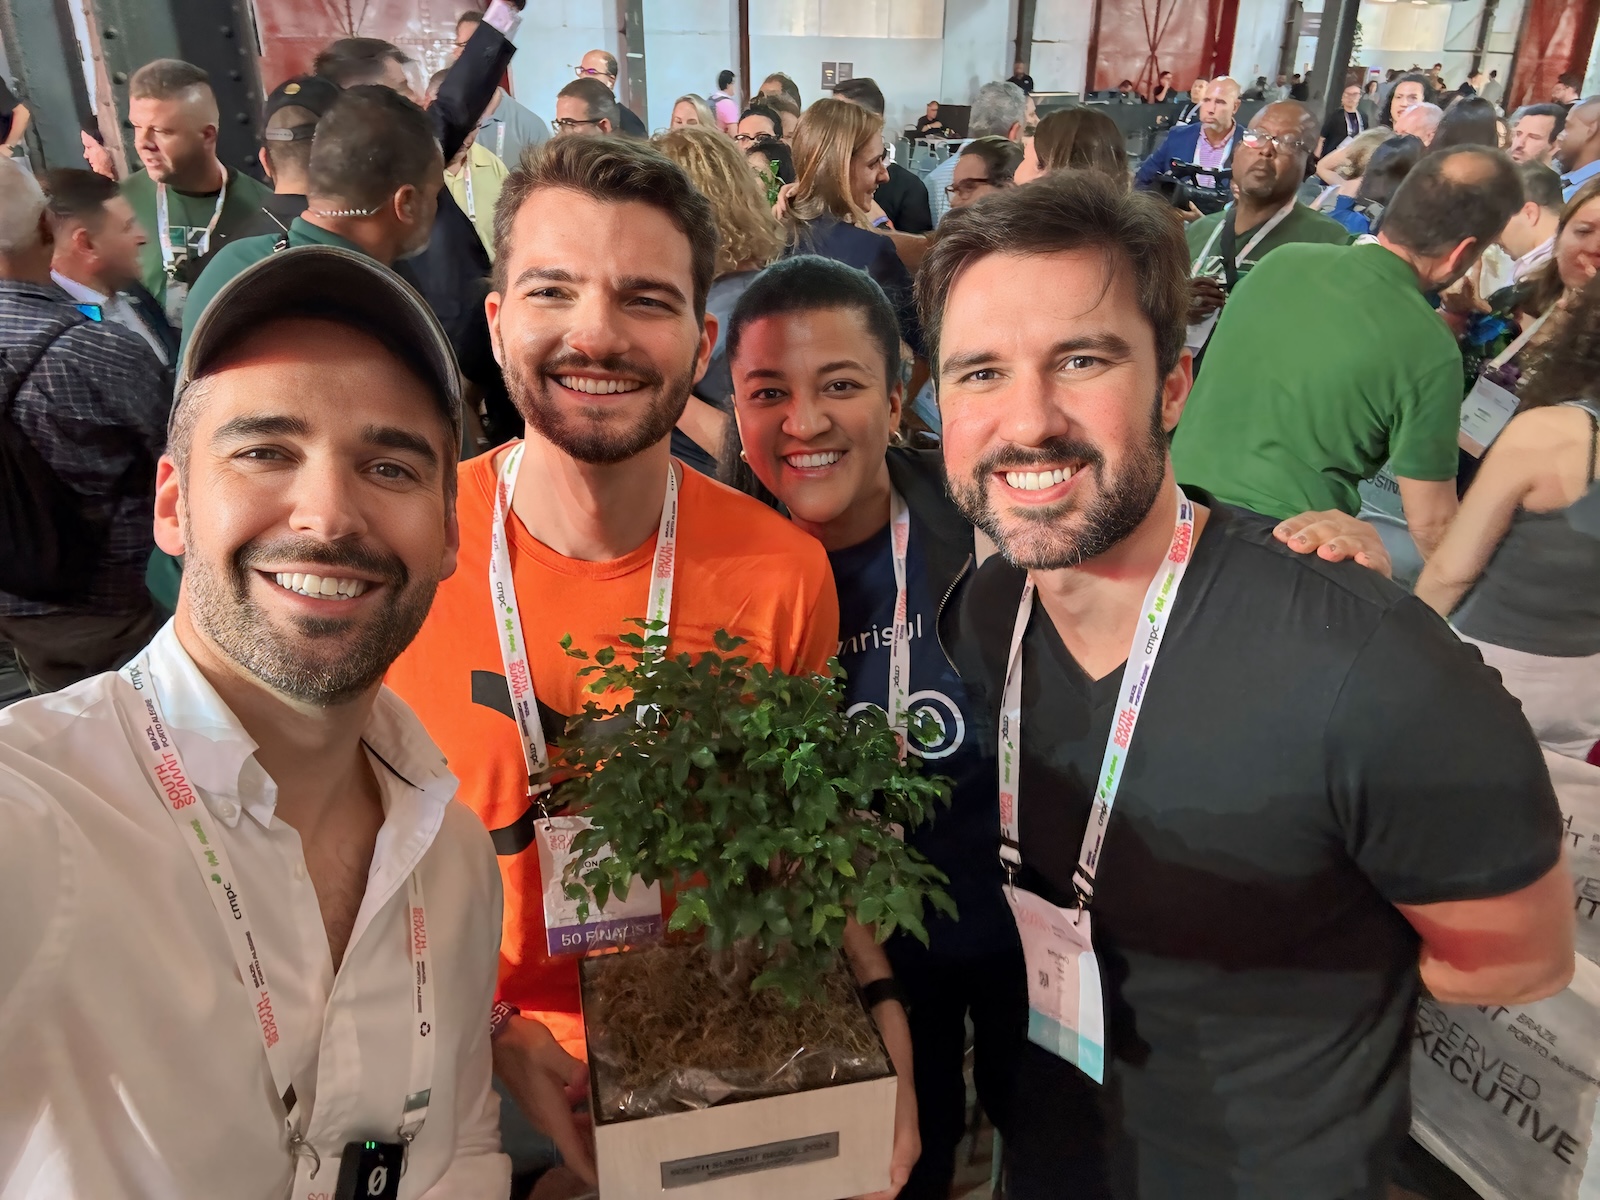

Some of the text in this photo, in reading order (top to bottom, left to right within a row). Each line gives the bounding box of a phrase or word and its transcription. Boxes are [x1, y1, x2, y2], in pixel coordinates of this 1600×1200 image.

[1145, 625, 1160, 655] cmpc
[516, 659, 529, 692] SOUTH
[145, 698, 169, 748] PORTO ALEGRE
[145, 725, 161, 751] BRAZIL
[1114, 709, 1128, 745] SOUTH
[154, 763, 184, 810] SOUTH
[162, 753, 197, 806] SUMMIT
[549, 831, 576, 843] SOU
[223, 882, 242, 920] cmpc
[561, 933, 582, 947] 50
[256, 1001, 275, 1048] SOUTH
[1506, 1024, 1549, 1059] PORTO
[1416, 1001, 1541, 1101] ESERVED
[1413, 1021, 1580, 1165] XECUTIVE
